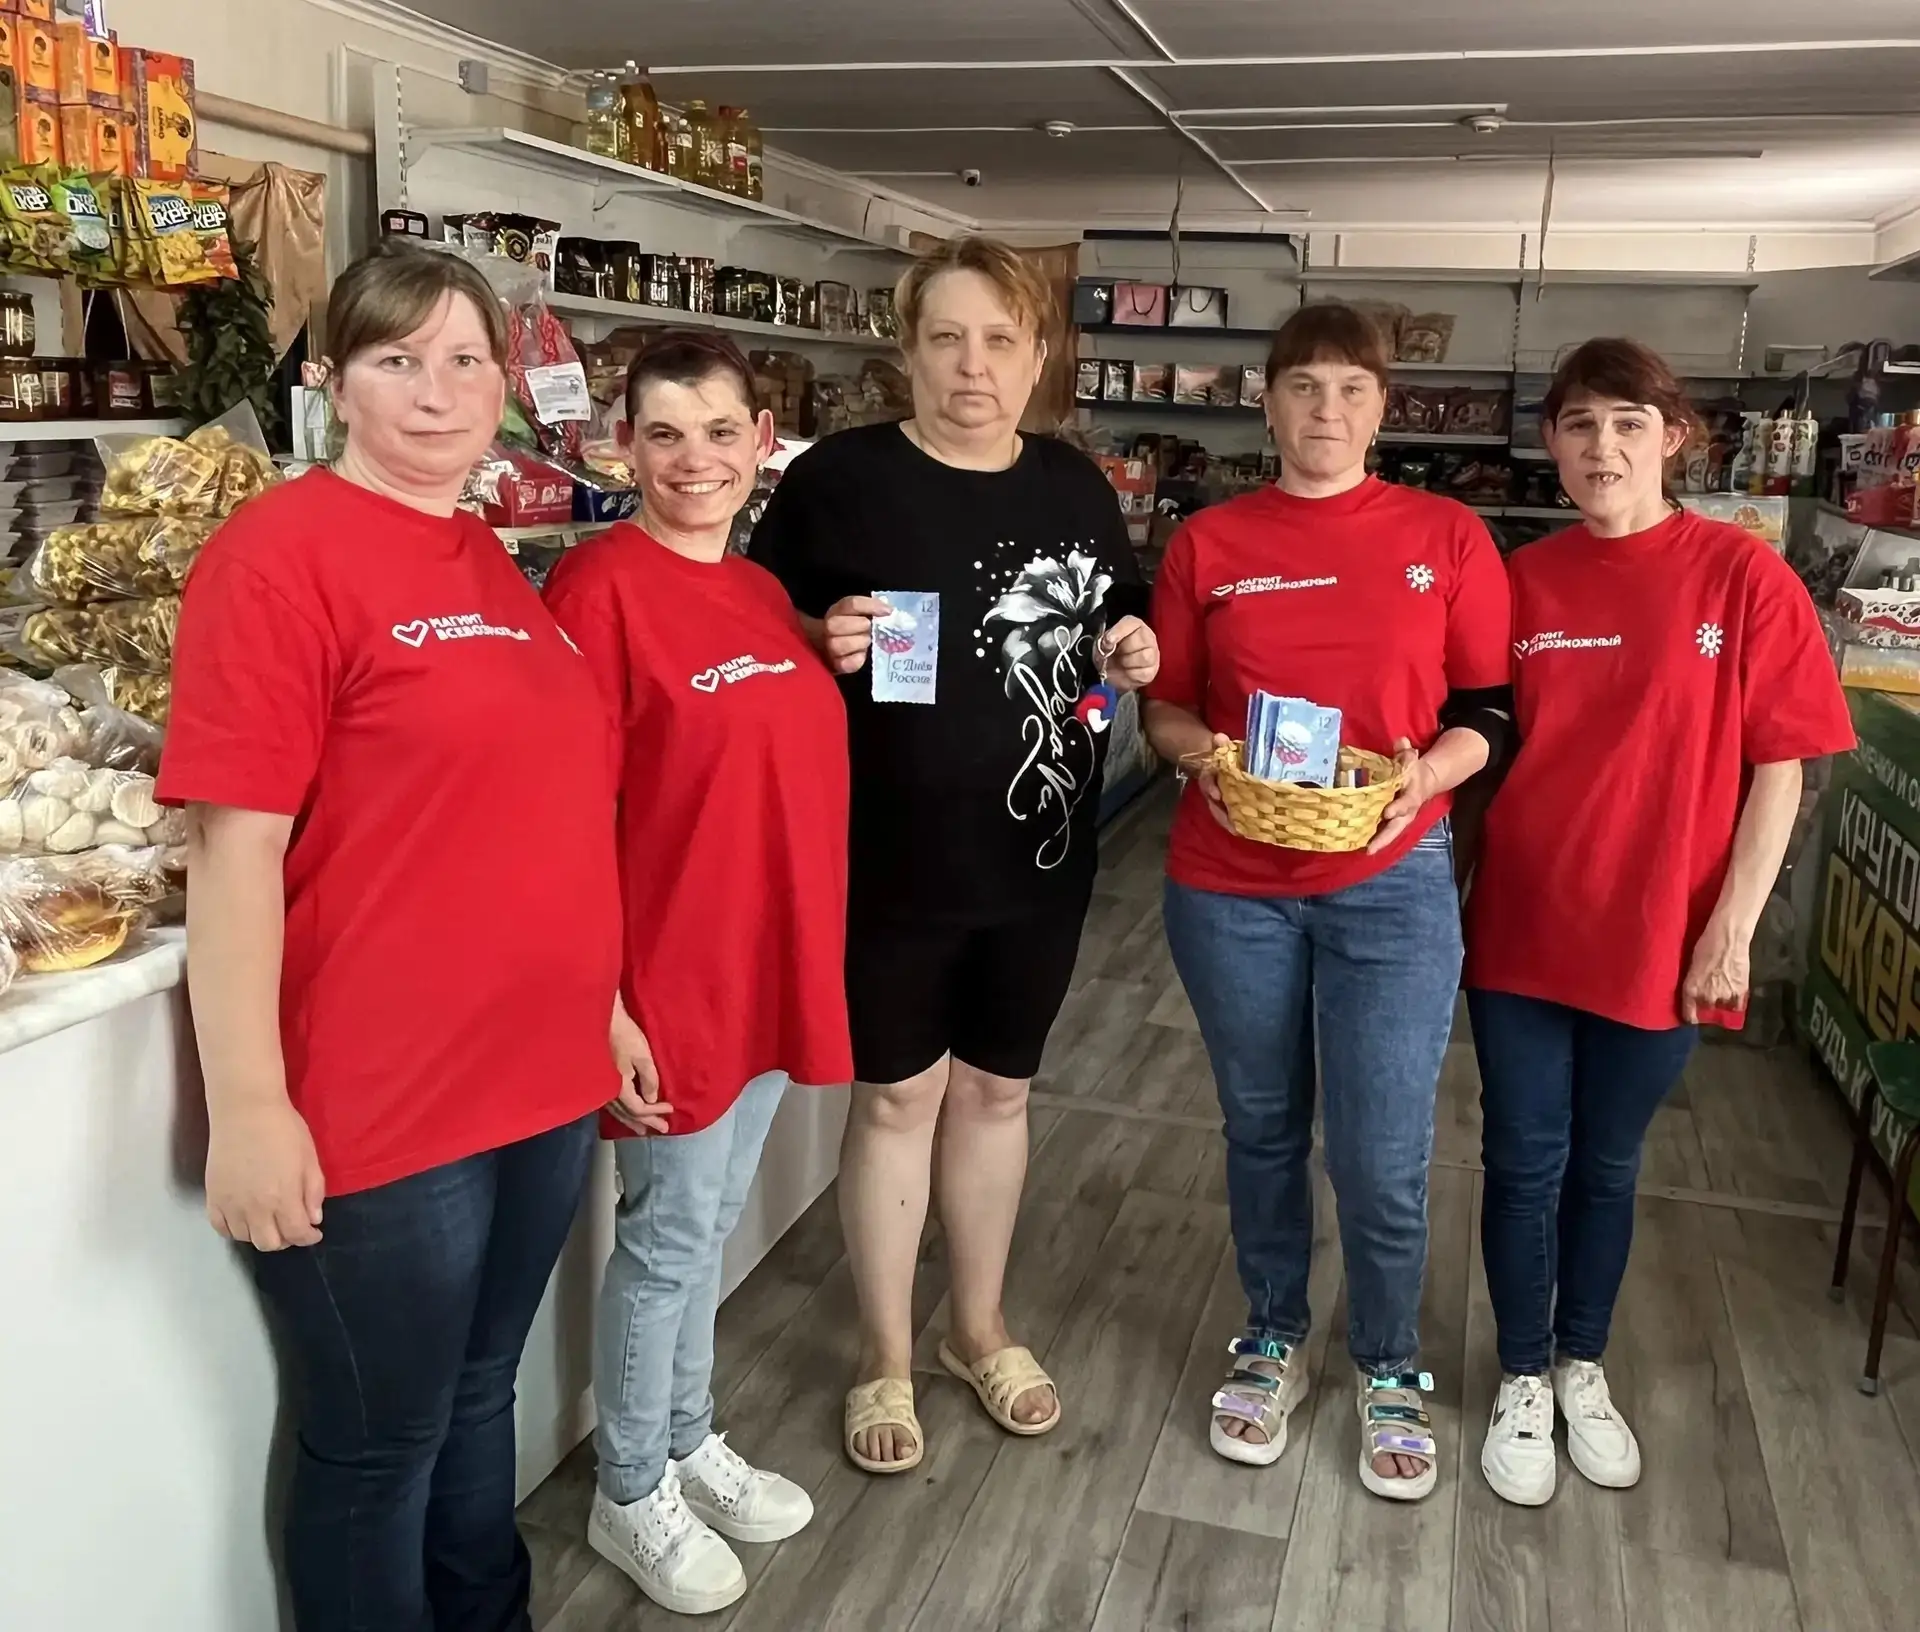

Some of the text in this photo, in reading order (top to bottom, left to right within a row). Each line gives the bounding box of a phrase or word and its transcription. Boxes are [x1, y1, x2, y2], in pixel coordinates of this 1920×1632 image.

[921, 601, 933, 613] 12
[429, 613, 484, 629] МАГНИТ
[1319, 716, 1332, 729] 12
[1838, 787, 1920, 932] КРУТО
[1810, 994, 1849, 1083] БУДЬ
